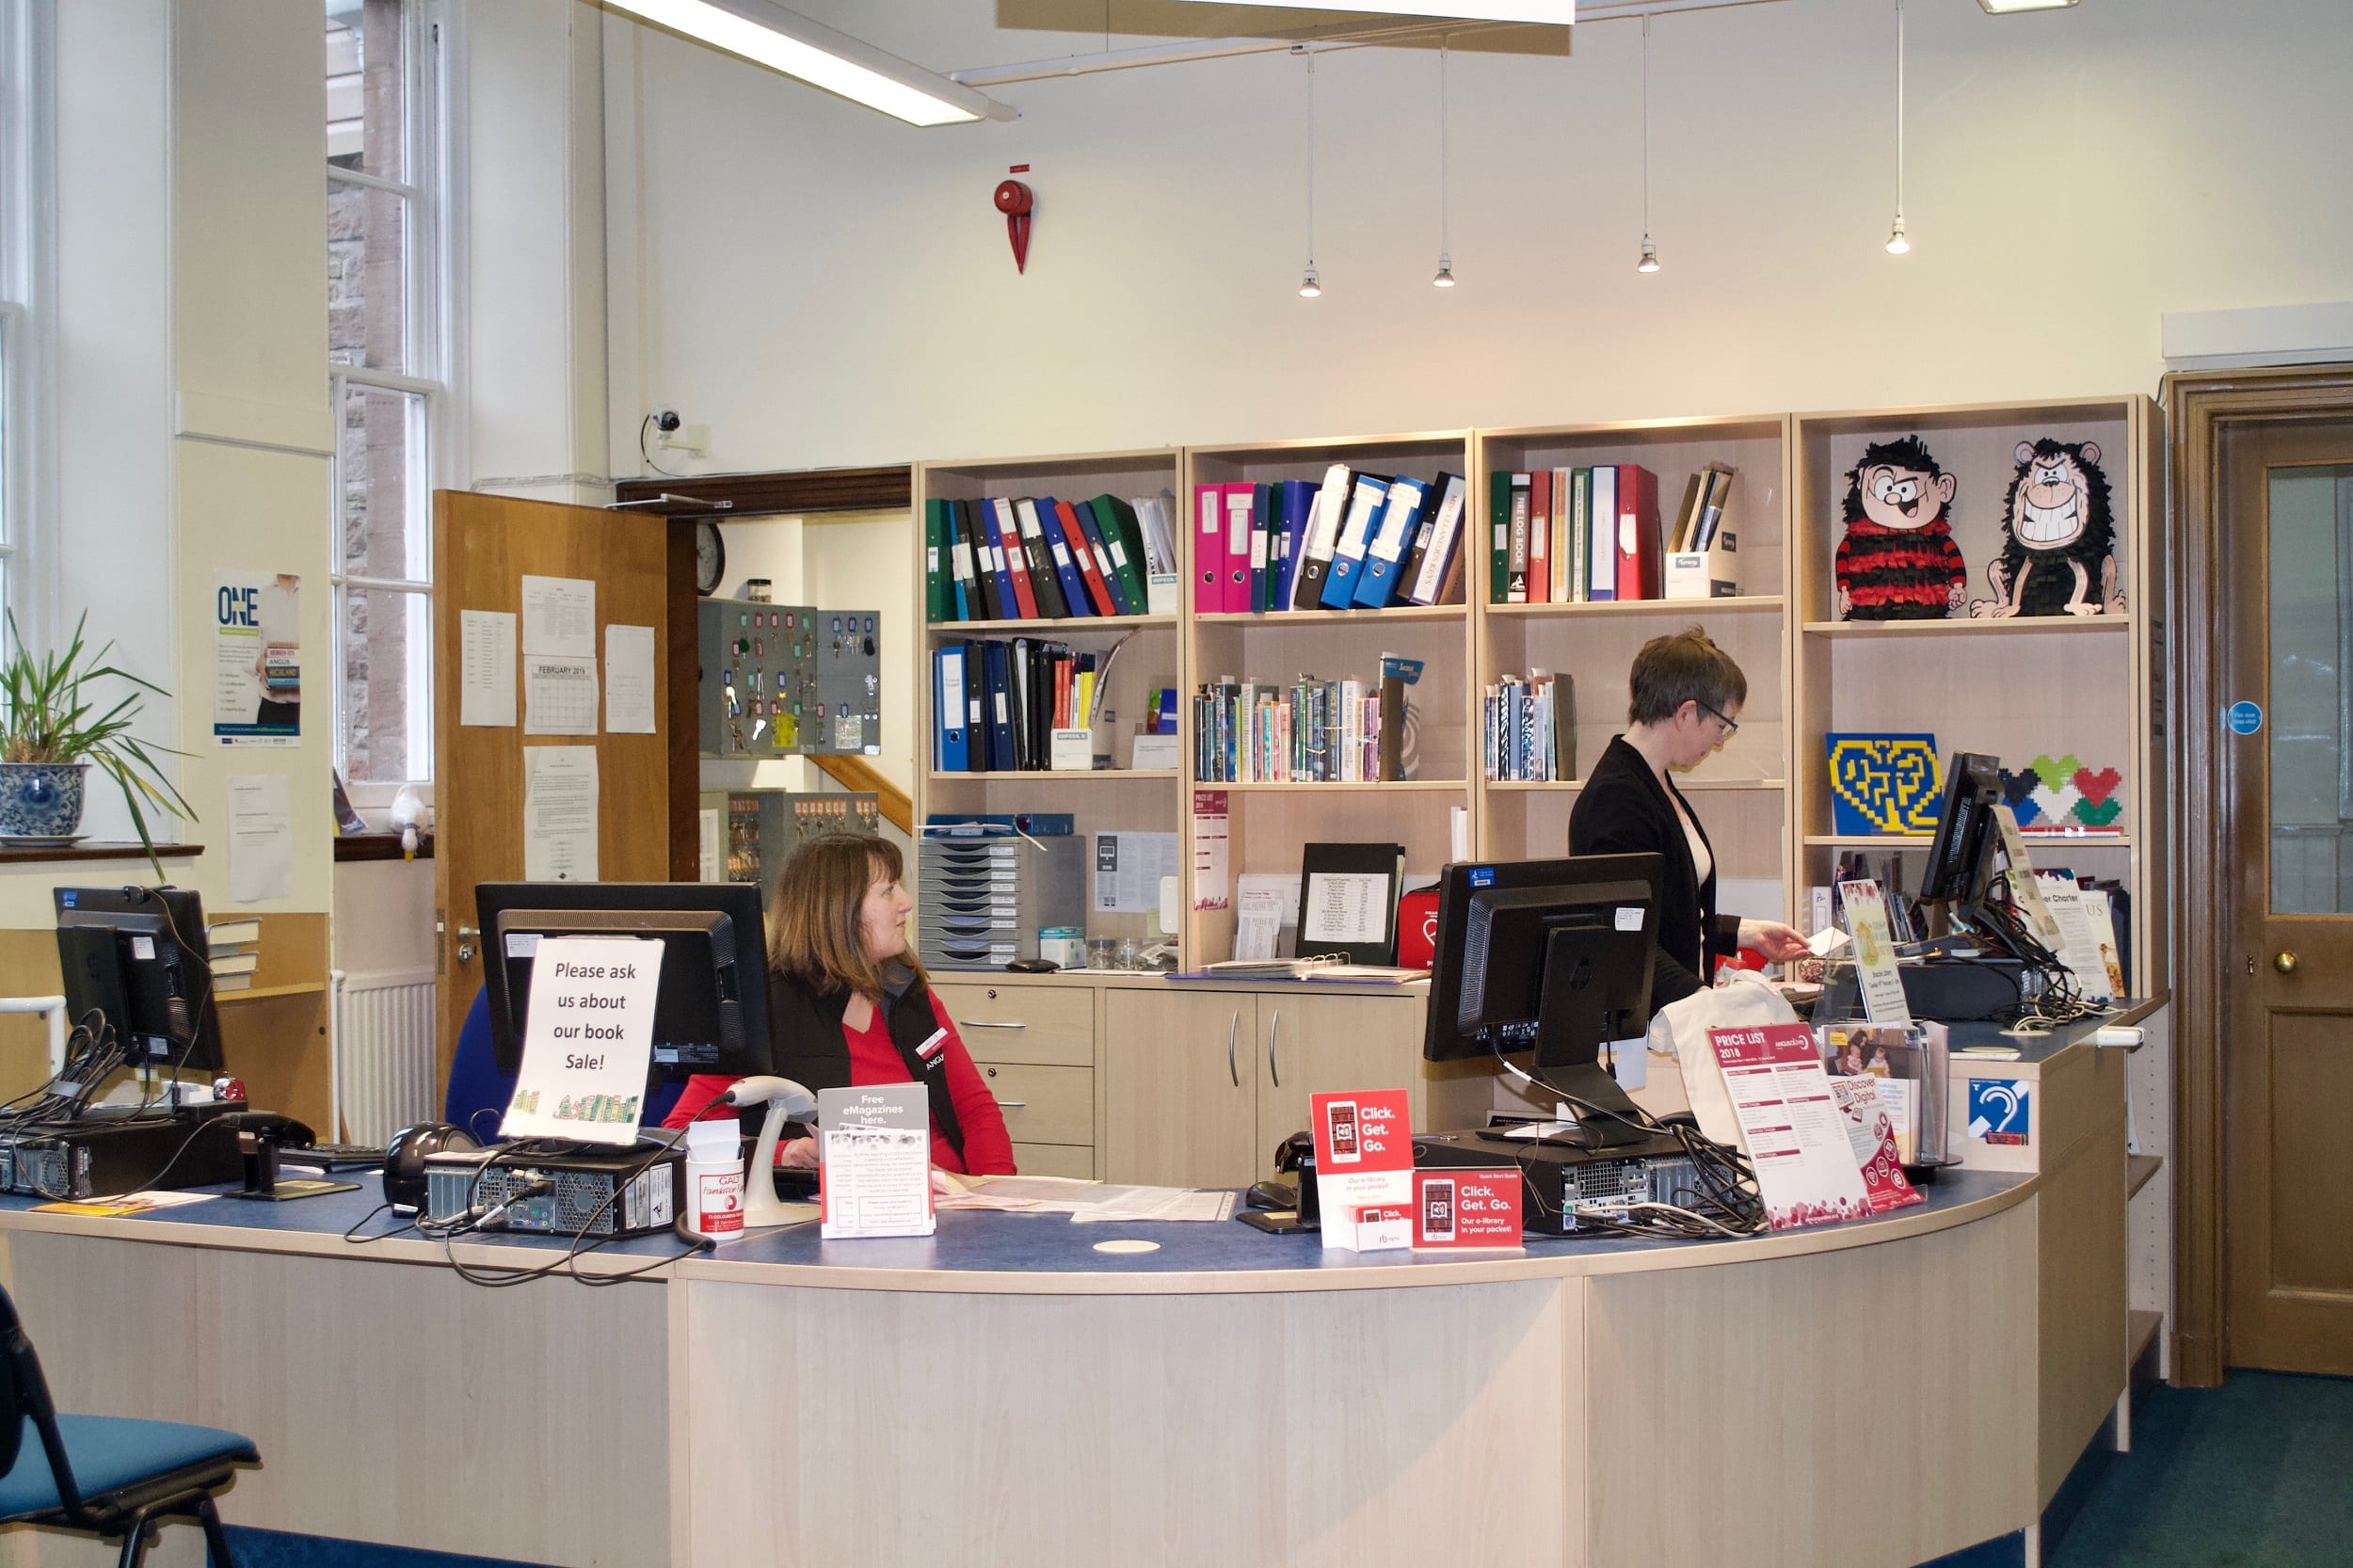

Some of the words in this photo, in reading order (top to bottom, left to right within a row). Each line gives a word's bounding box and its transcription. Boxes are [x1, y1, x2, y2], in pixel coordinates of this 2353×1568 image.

[1516, 497, 1525, 515] FIRE
[1433, 494, 1458, 562] MISCELLANEOUS
[1515, 516, 1524, 536] LOG
[1515, 537, 1524, 565] BOOK
[1425, 563, 1438, 585] KEYS
[217, 585, 259, 626] ONE
[538, 665, 571, 674] FEBRUARY
[1243, 688, 1252, 726] William
[1242, 728, 1251, 753] Boyd
[555, 962, 605, 978] Please
[610, 964, 636, 979] ask
[557, 996, 575, 1008] us
[579, 993, 627, 1009] about
[553, 1026, 580, 1038] our
[584, 1024, 625, 1040] book
[1715, 1033, 1746, 1047] PRICE
[1746, 1032, 1766, 1045] LIST
[1720, 1048, 1741, 1059] 2018
[566, 1054, 605, 1070] Sale!
[926, 1053, 944, 1070] ANGU
[1847, 1078, 1875, 1091] Discover
[861, 1095, 885, 1104] Free
[1853, 1090, 1876, 1105] Digital
[842, 1105, 904, 1115] eMagazines
[1360, 1107, 1396, 1120] Click.
[860, 1115, 887, 1125] here.
[1362, 1123, 1389, 1136] Get.
[1363, 1139, 1385, 1152] Go.
[719, 1176, 740, 1185] GALT
[1461, 1186, 1495, 1197] Click.
[1461, 1199, 1487, 1210] Get.
[1490, 1199, 1512, 1210] Go.
[1475, 1217, 1505, 1226] e-library
[1486, 1225, 1513, 1234] pocket!
